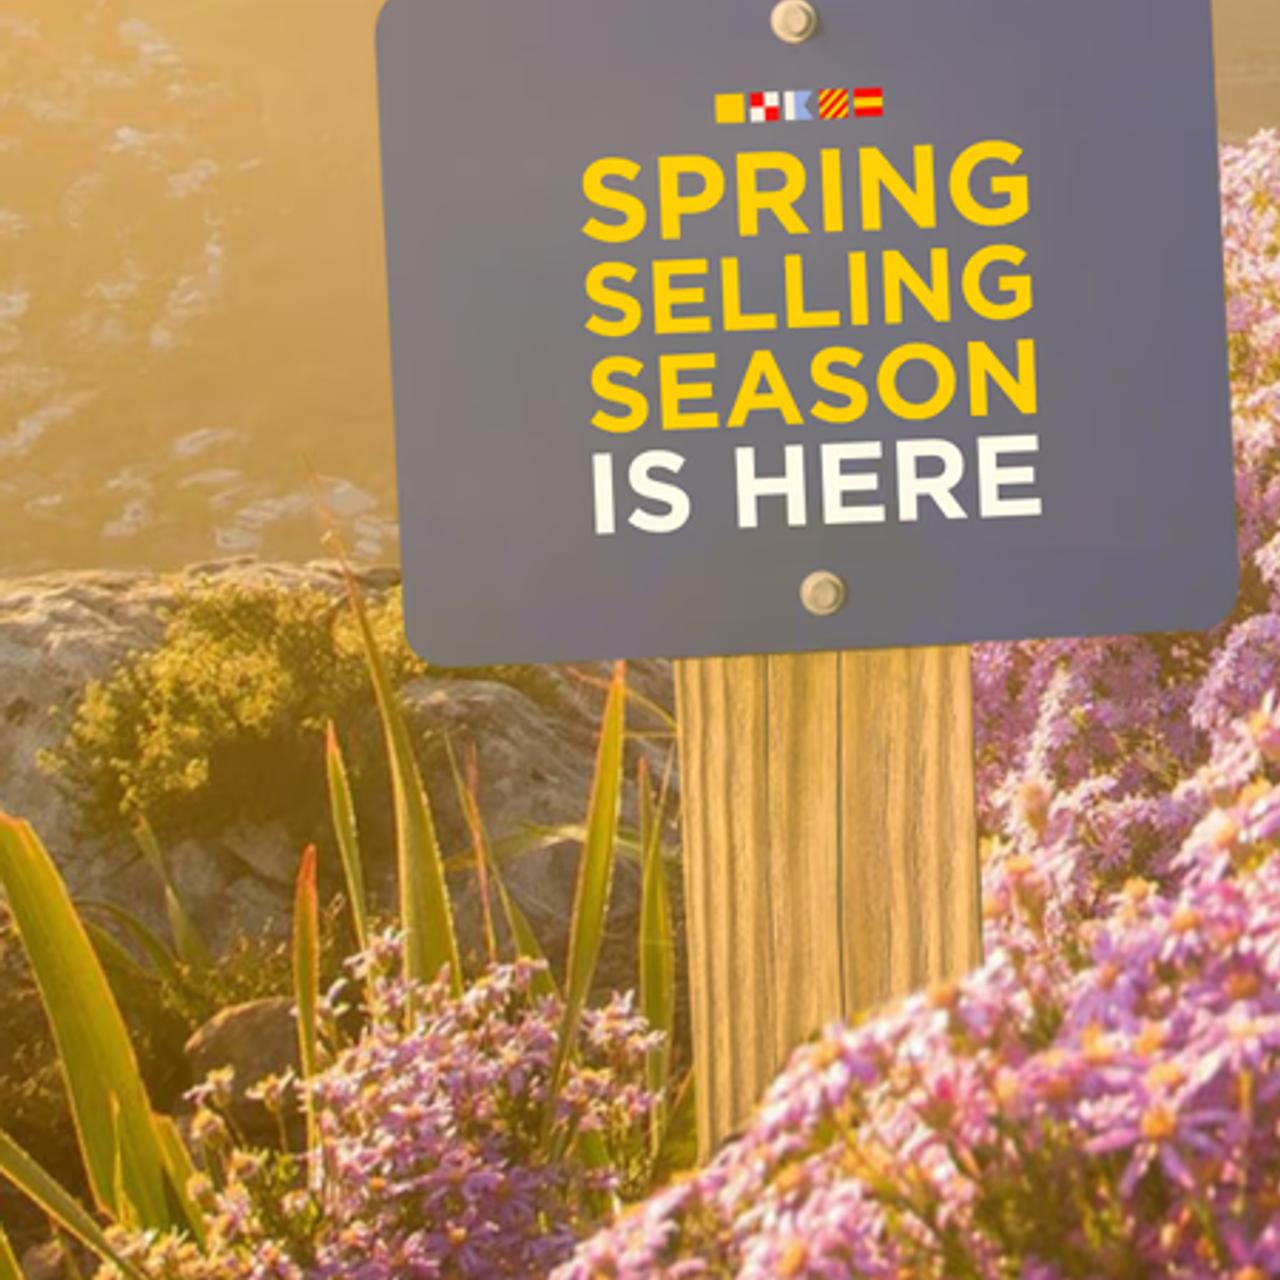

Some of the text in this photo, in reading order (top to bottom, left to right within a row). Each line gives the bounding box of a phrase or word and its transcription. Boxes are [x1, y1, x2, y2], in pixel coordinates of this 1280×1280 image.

[581, 139, 1030, 244] SPRING
[584, 244, 1033, 338] SELLING
[591, 338, 1037, 434] SEASON
[592, 434, 1042, 535] IS HERE
